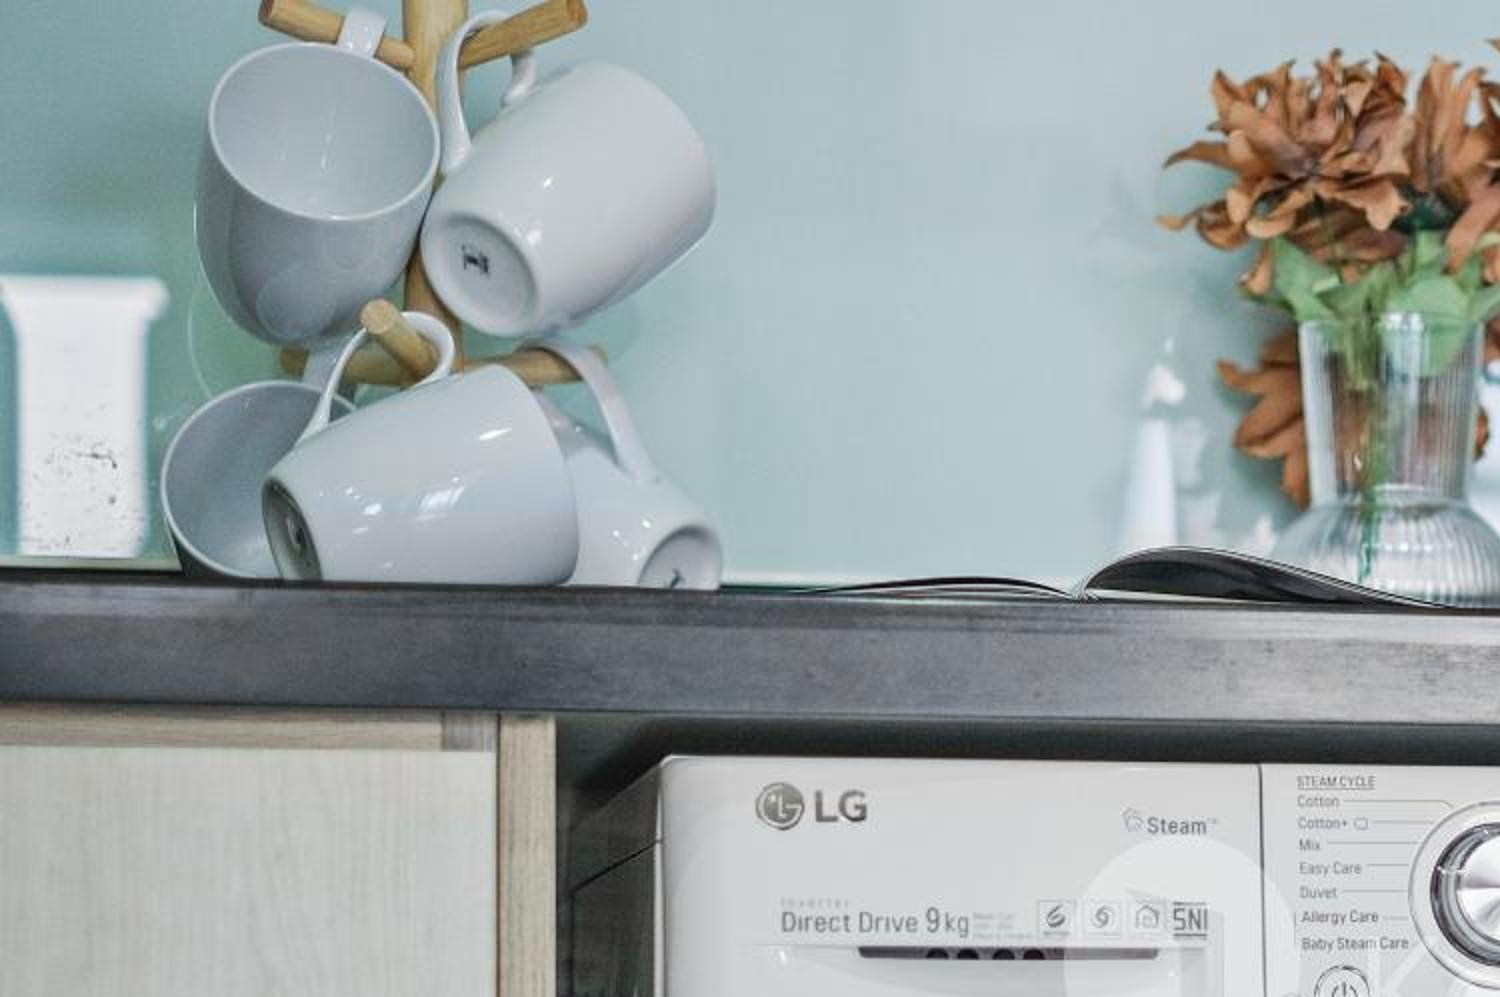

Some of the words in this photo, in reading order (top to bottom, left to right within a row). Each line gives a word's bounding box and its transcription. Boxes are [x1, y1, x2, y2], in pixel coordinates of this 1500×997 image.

[1297, 775, 1338, 787] STEAM
[1340, 775, 1376, 787] CYCLE
[815, 789, 867, 822] LG
[1297, 795, 1340, 808] Cotton
[1147, 816, 1207, 836] Steam
[1299, 838, 1321, 851] Mix
[1300, 862, 1329, 878] Easy
[1333, 861, 1362, 874] Care
[1300, 885, 1338, 899] Duvet
[781, 911, 851, 934] Direct
[858, 911, 919, 933] Drive
[925, 905, 941, 933] 9
[945, 912, 970, 938] kg
[1301, 910, 1347, 926] Allergy
[1349, 909, 1379, 923] Care
[1302, 937, 1334, 953] Baby
[1337, 937, 1378, 950] Steam
[1380, 937, 1409, 950] Care
